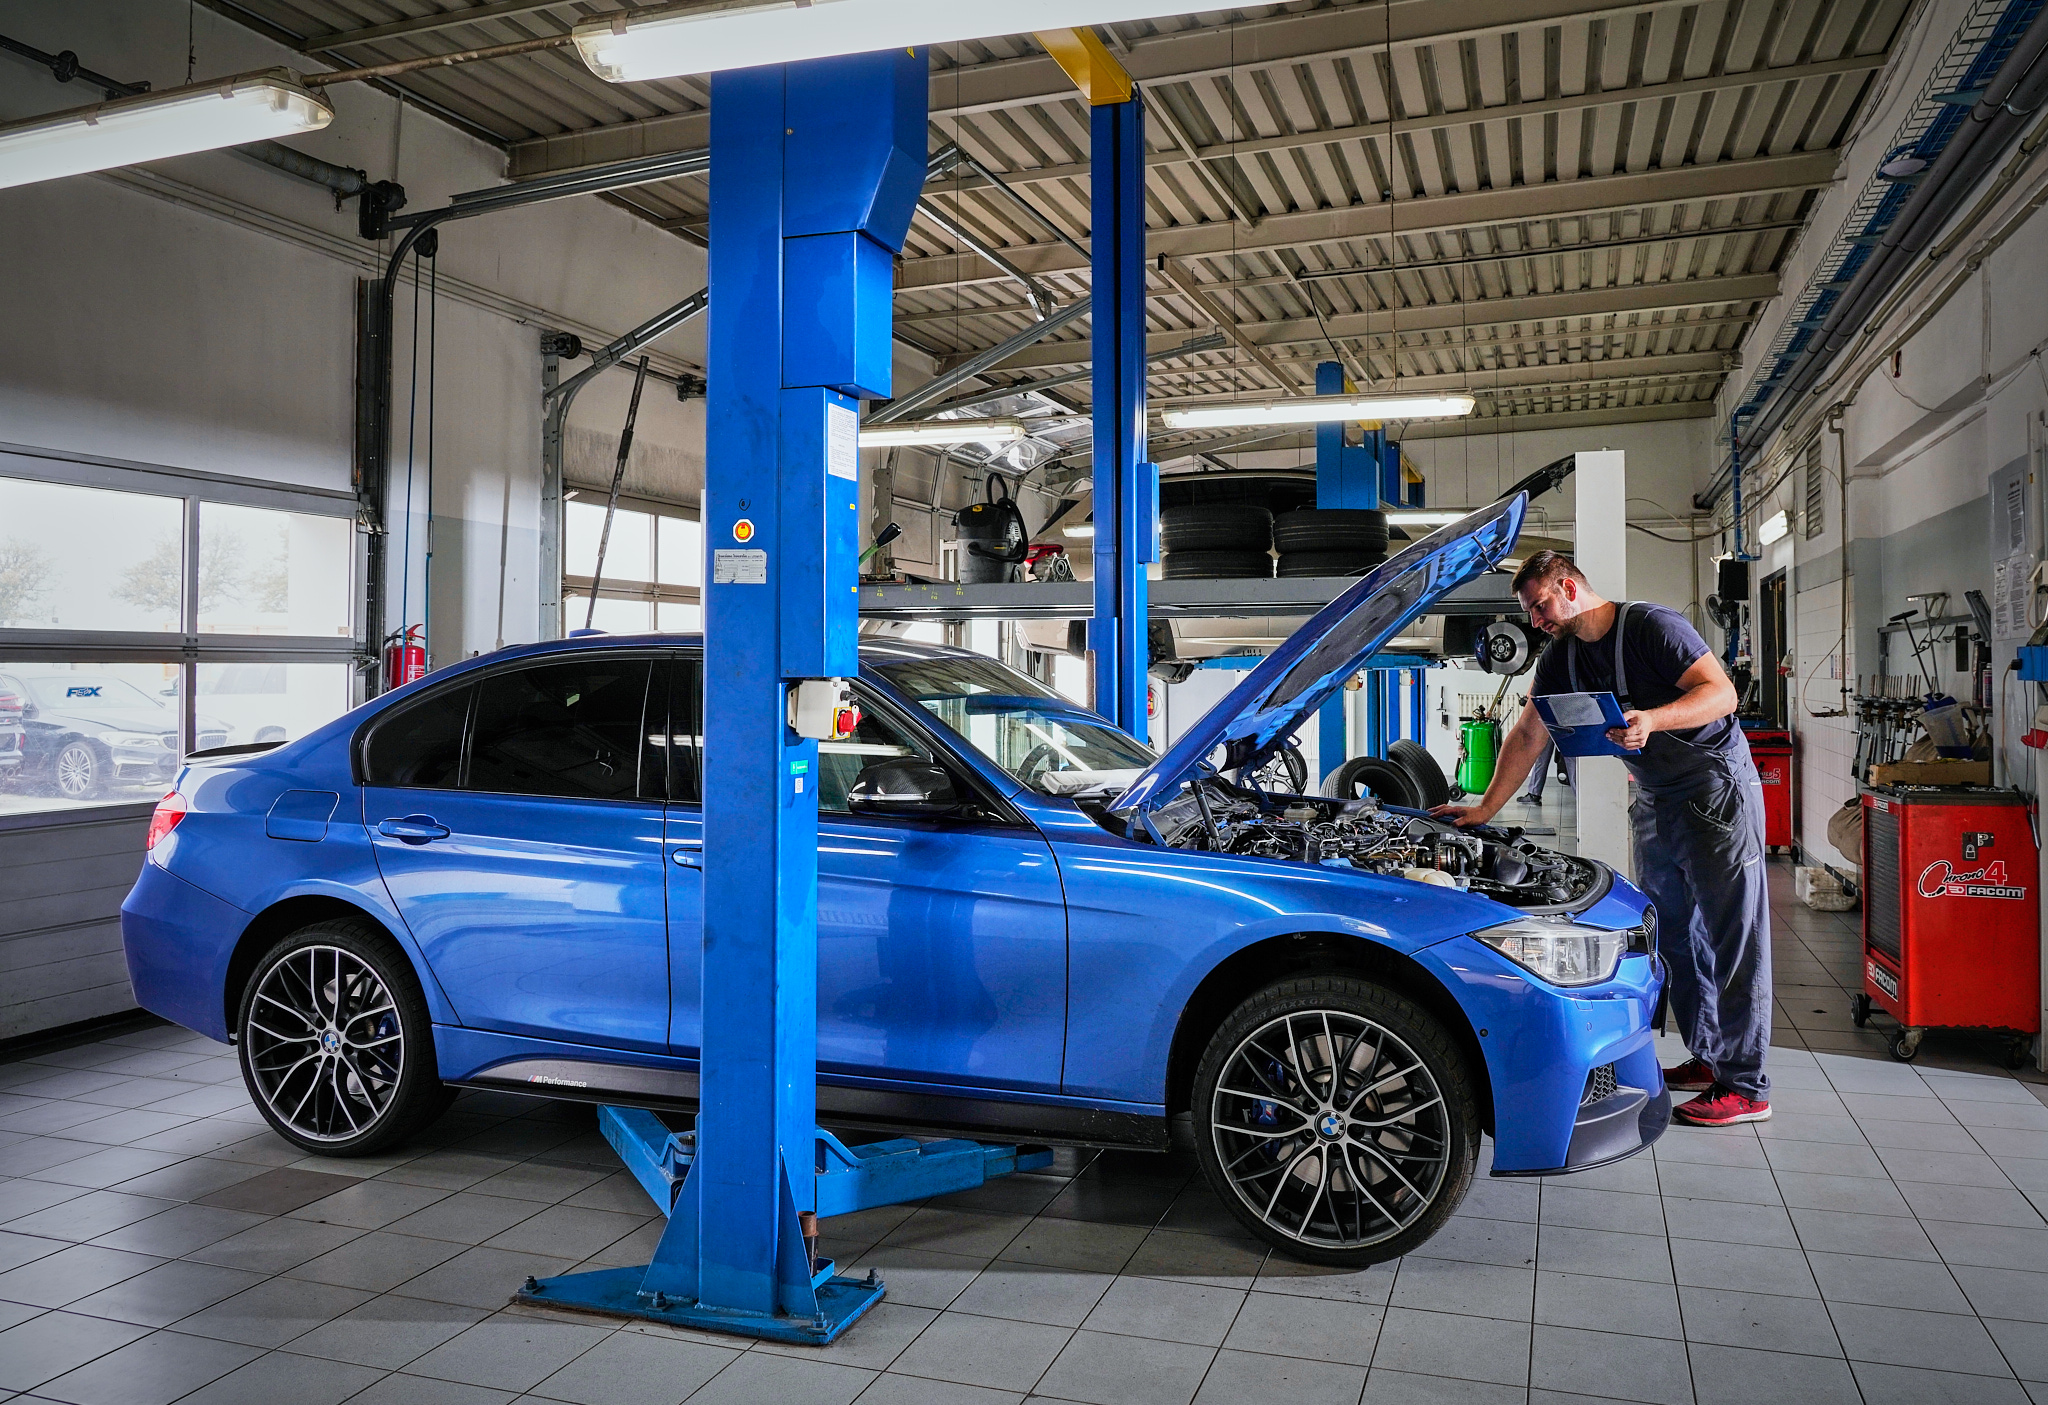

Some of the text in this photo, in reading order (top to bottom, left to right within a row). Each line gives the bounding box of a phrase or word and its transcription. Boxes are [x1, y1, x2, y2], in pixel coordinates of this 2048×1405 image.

[66, 686, 103, 698] FOX
[1917, 859, 2008, 898] Chrono 4
[1968, 887, 2022, 897] FACOM
[1875, 967, 1897, 996] FACOM
[1270, 998, 1307, 1014] MAXX
[543, 1076, 587, 1088] Performance
